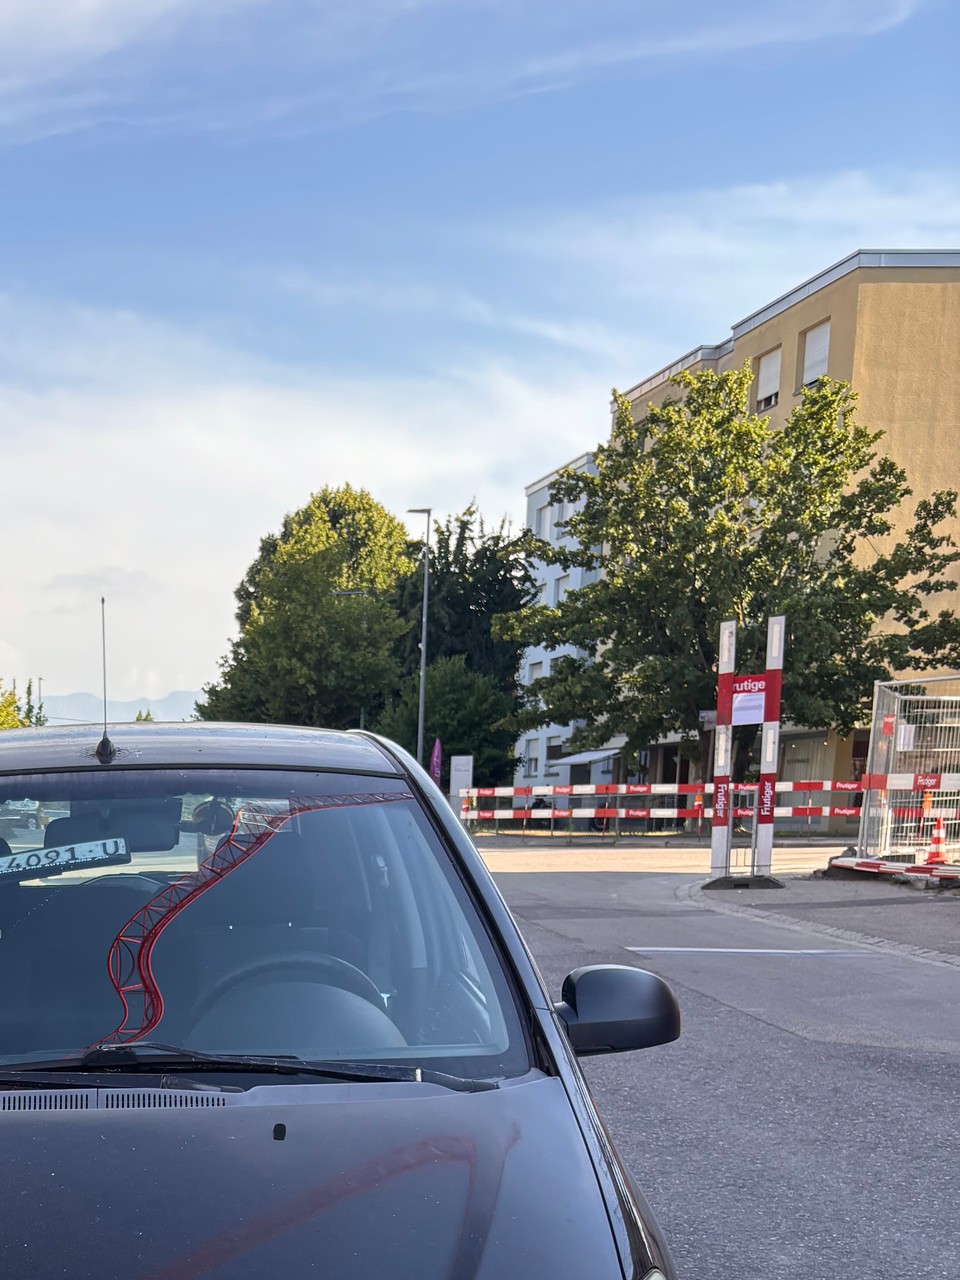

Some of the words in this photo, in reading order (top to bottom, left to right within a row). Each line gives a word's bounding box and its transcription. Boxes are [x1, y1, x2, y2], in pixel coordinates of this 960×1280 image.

[732, 679, 766, 692] rutige
[716, 784, 728, 818] Frutiger
[761, 781, 773, 816] Frutiger
[7, 846, 79, 869] 4091
[101, 840, 119, 856] U
